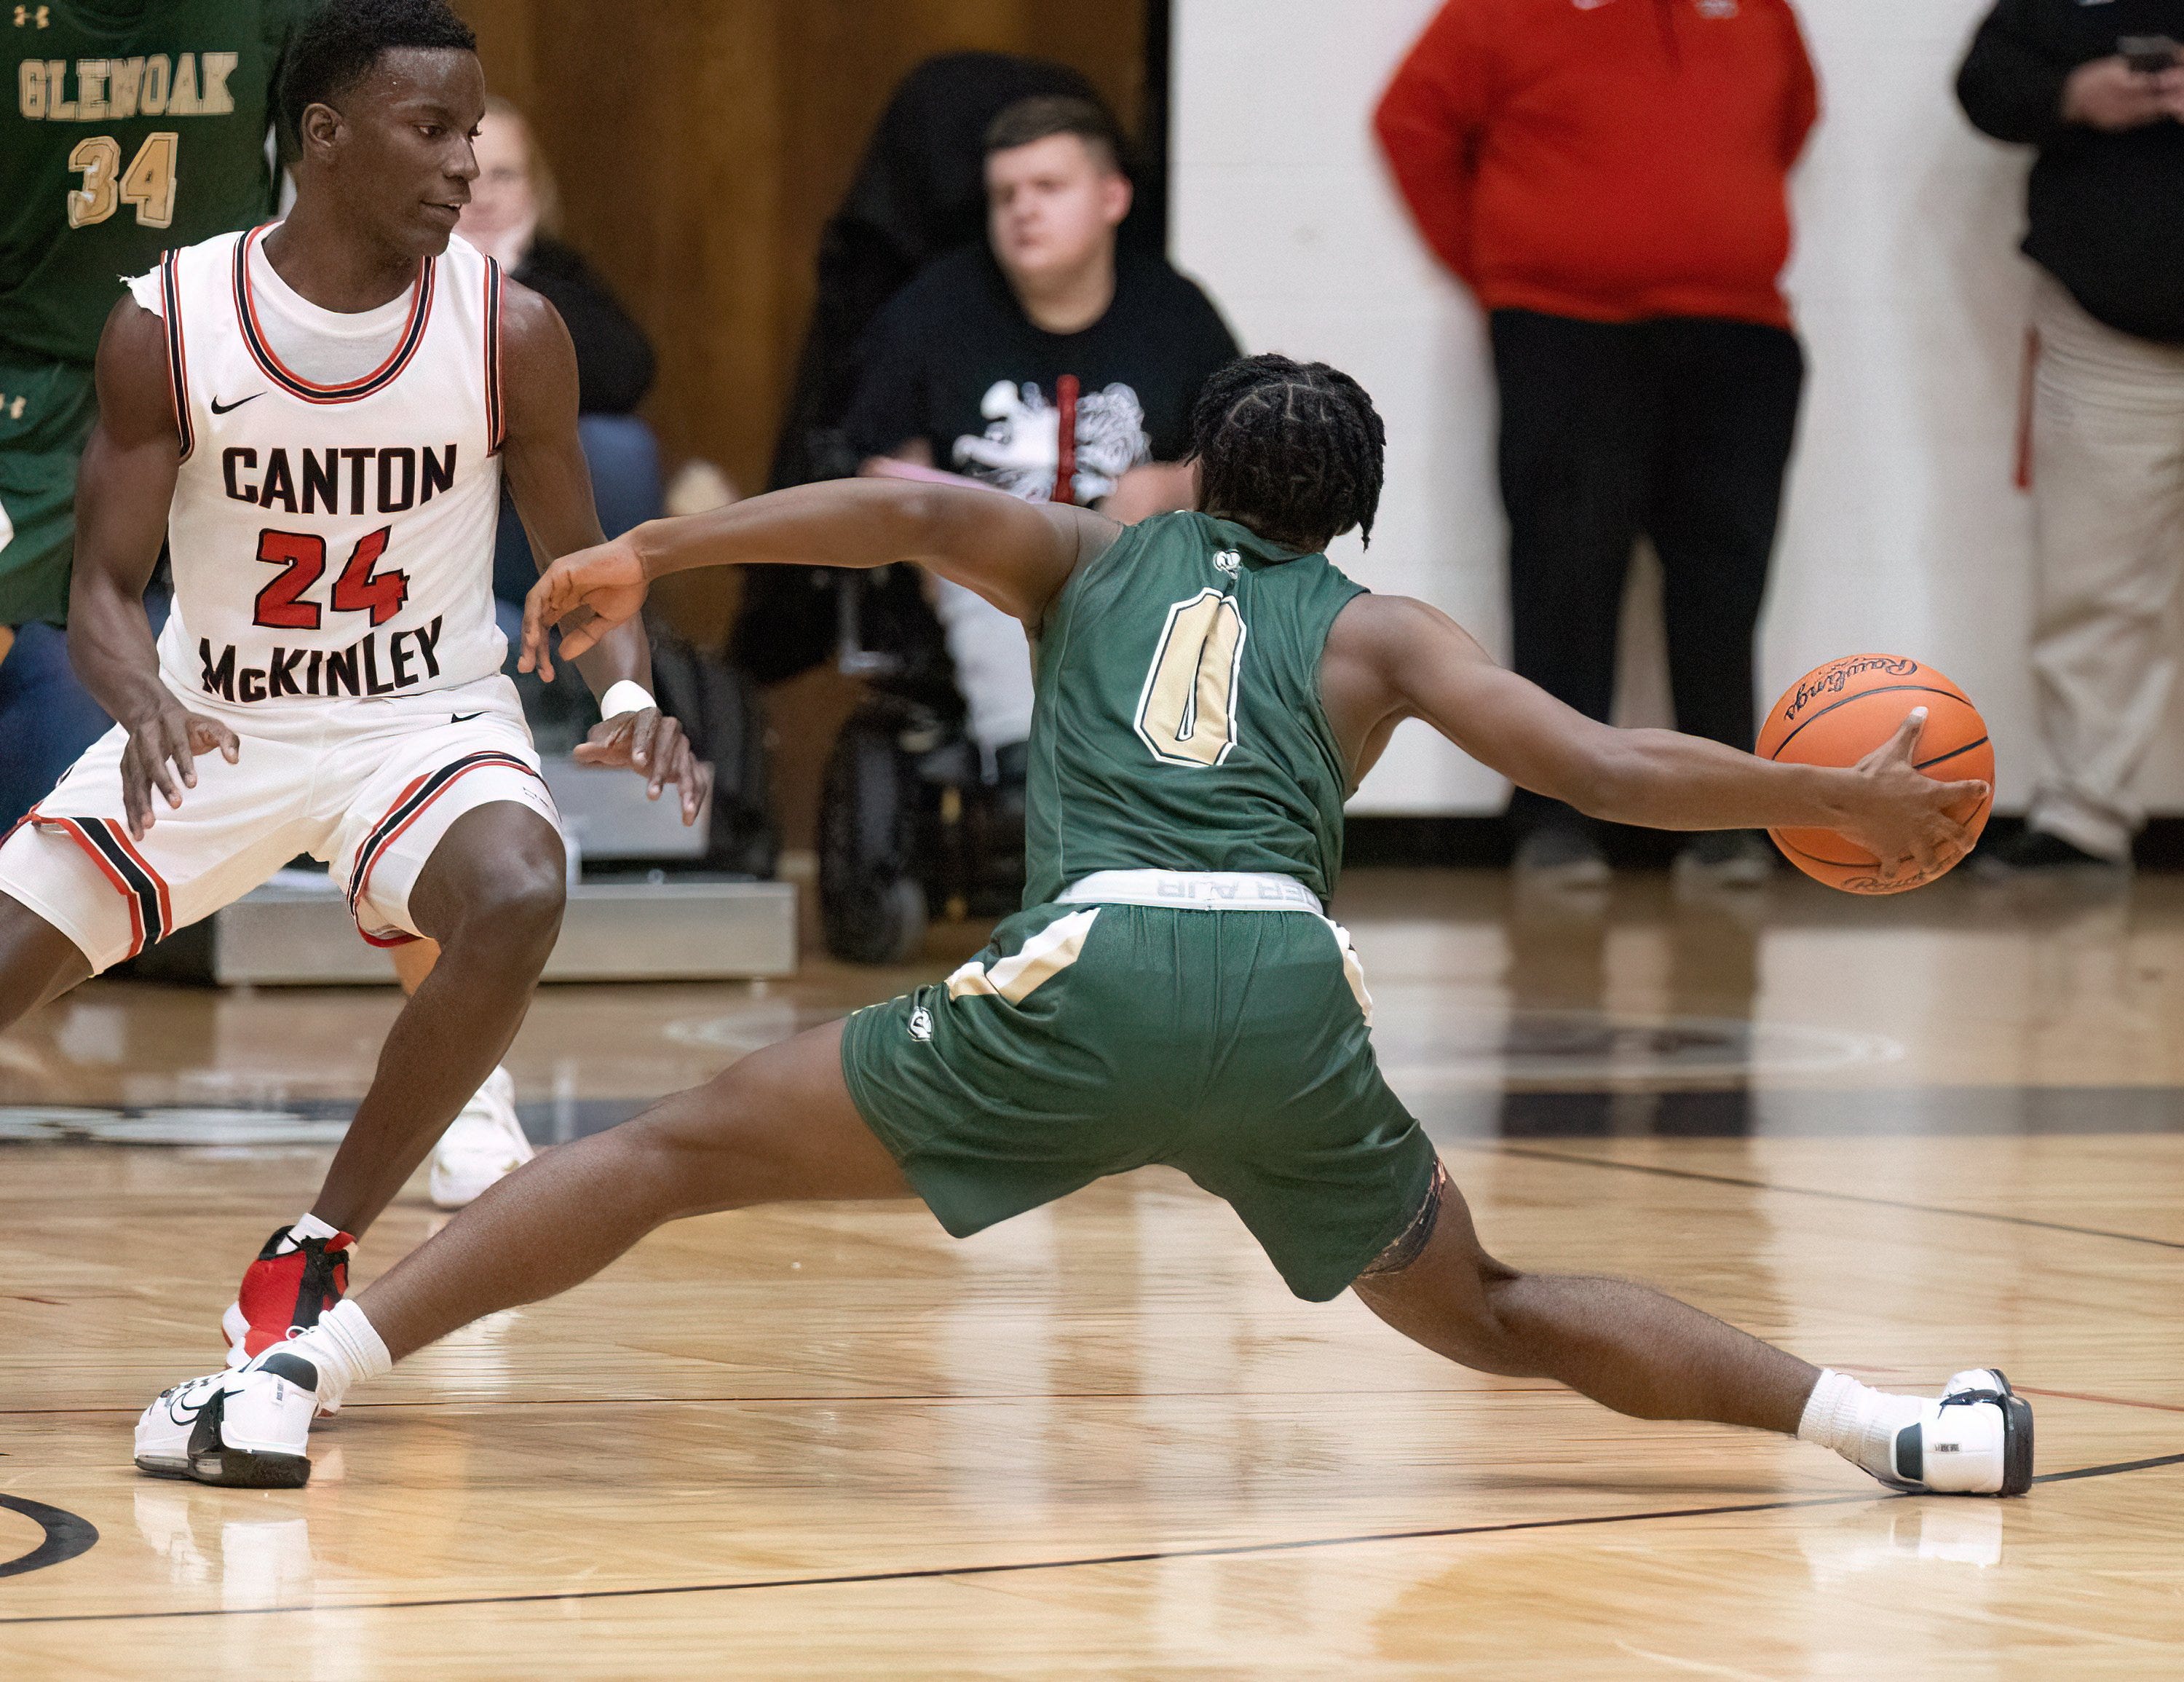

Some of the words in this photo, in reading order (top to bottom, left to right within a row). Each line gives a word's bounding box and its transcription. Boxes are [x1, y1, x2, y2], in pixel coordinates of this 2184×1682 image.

[19, 52, 238, 122] GLENOAK
[68, 132, 178, 229] 34
[222, 443, 457, 515] CANTON
[252, 525, 410, 630] 24
[199, 614, 442, 703] McKINLEY
[1133, 587, 1247, 768] 0
[1784, 658, 1918, 720] Rawlings
